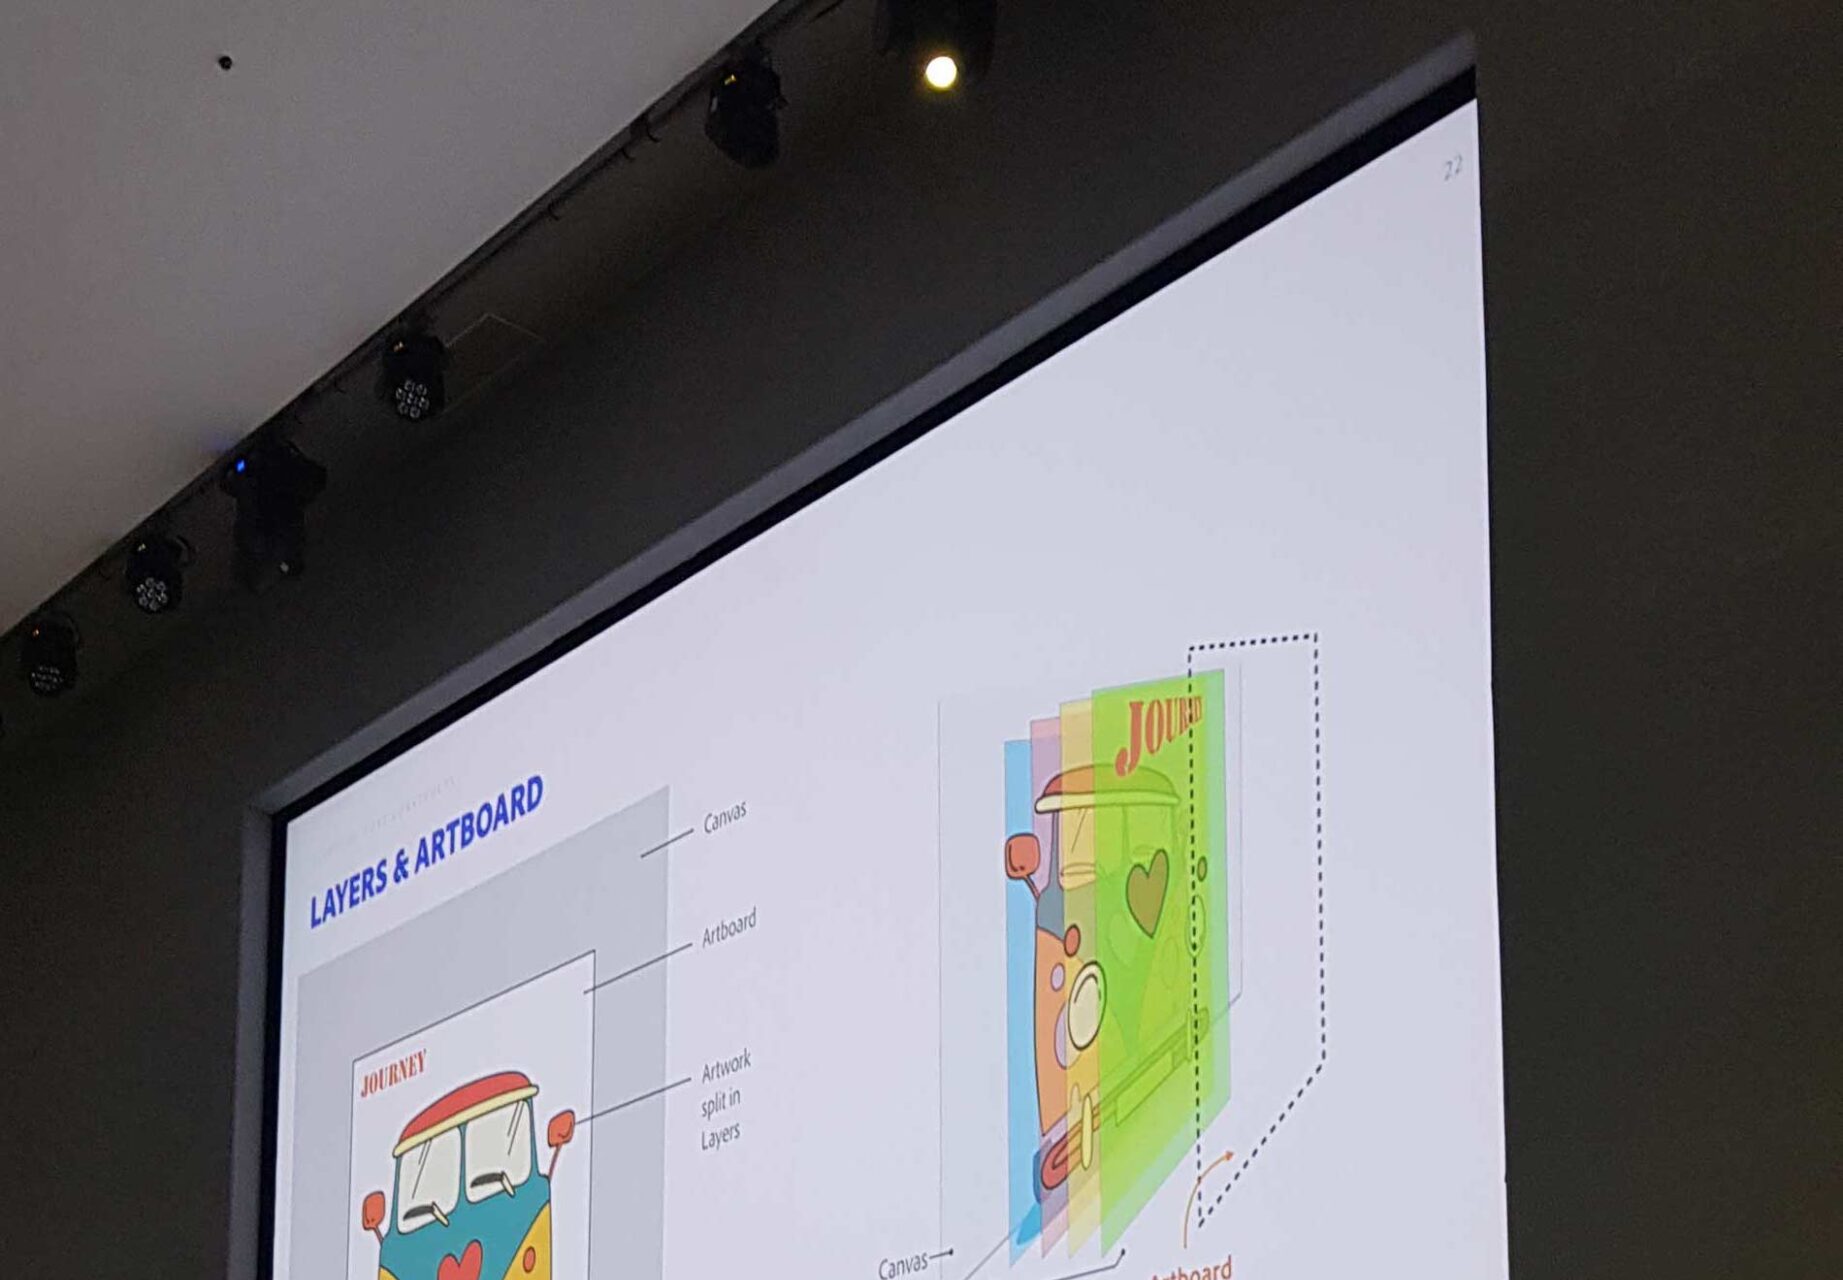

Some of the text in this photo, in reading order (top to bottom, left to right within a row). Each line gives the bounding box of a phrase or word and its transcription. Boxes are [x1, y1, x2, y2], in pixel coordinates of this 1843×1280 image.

[703, 801, 747, 835] Canvas
[310, 857, 388, 930] LAYERS
[393, 848, 409, 884] &
[414, 775, 544, 875] ARTBOARD
[702, 907, 757, 948] Artboard
[361, 1048, 428, 1098] JOURNEY
[702, 1047, 751, 1084] Artwork
[701, 1086, 741, 1121] split in
[701, 1122, 741, 1151] Layers
